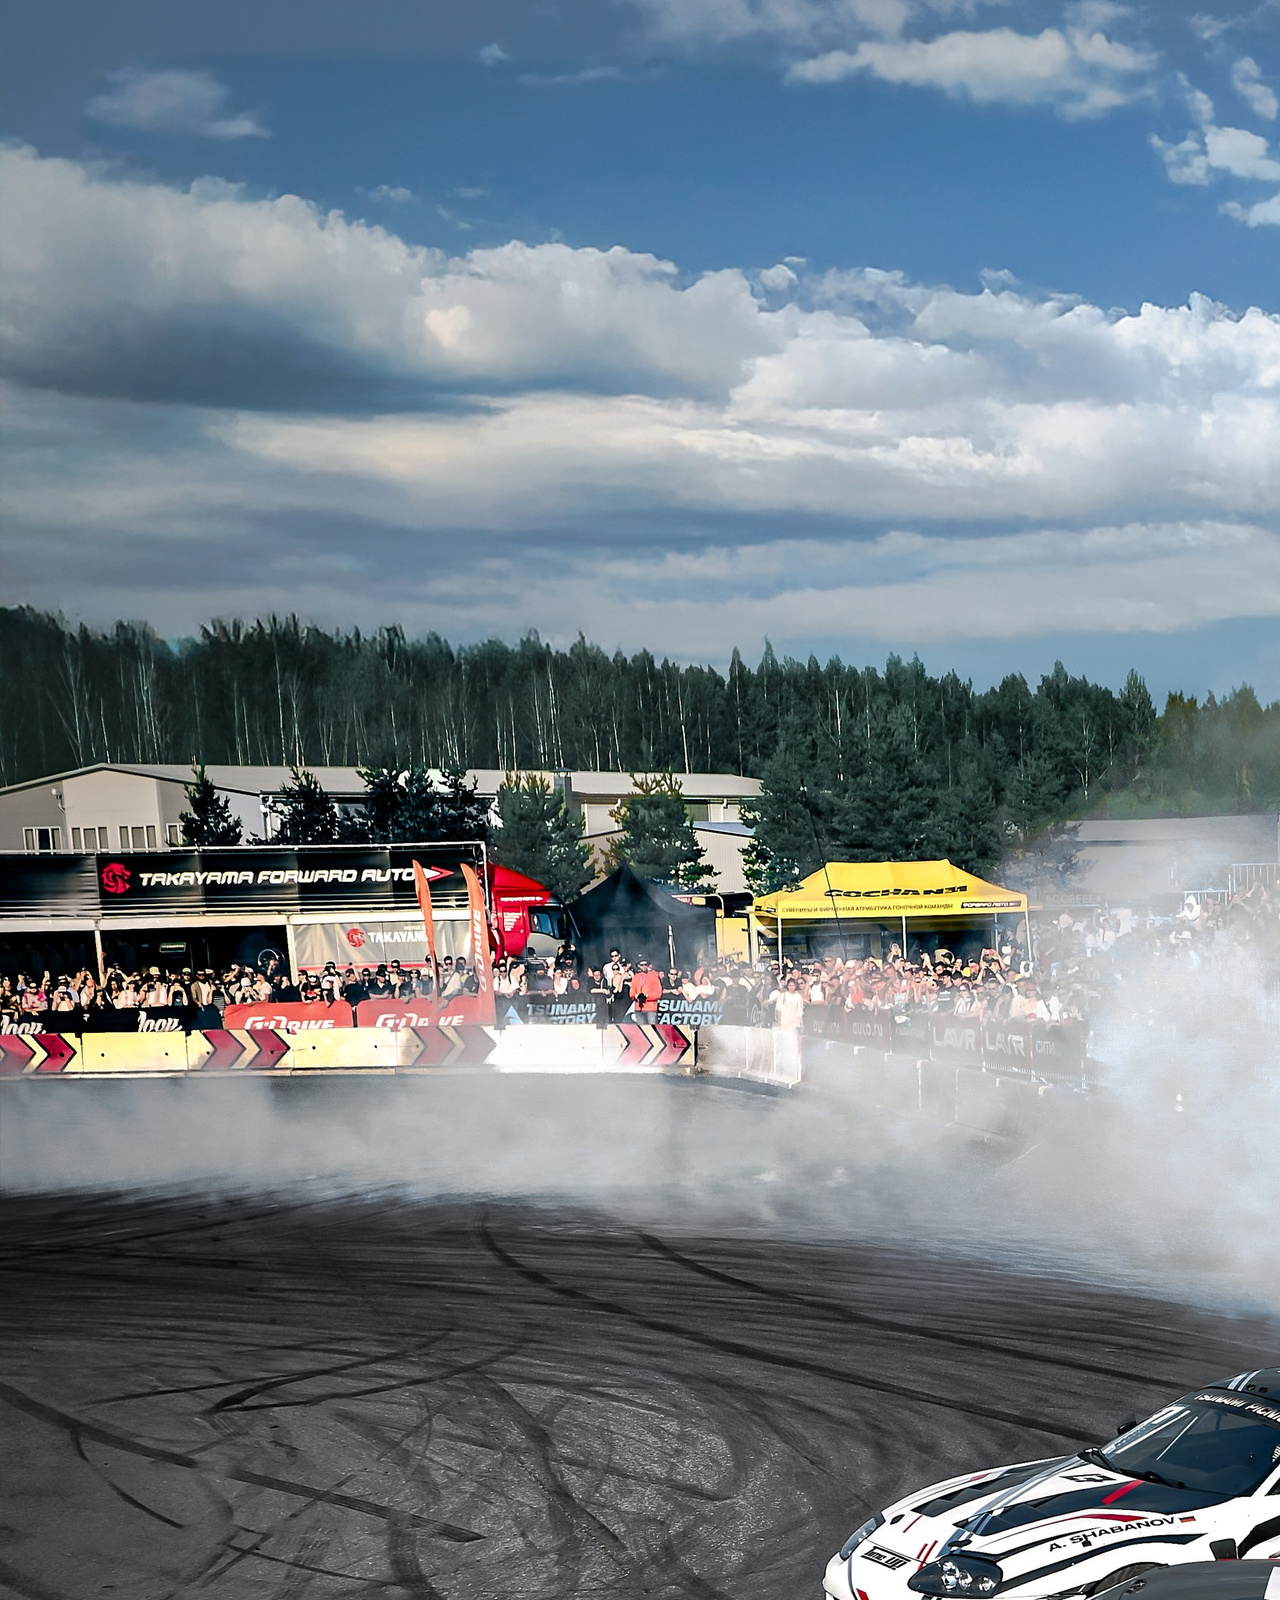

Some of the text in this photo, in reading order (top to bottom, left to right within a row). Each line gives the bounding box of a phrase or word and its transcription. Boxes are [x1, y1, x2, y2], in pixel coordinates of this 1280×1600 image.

[139, 868, 416, 887] TAKAYAMA FORWARD AUTO
[367, 931, 429, 943] TAKAYAM
[527, 1003, 596, 1016] TSUNAMI
[657, 999, 723, 1013] SUNAMI
[932, 1026, 976, 1050] LAVR
[1069, 1516, 1175, 1544] SHABANOV
